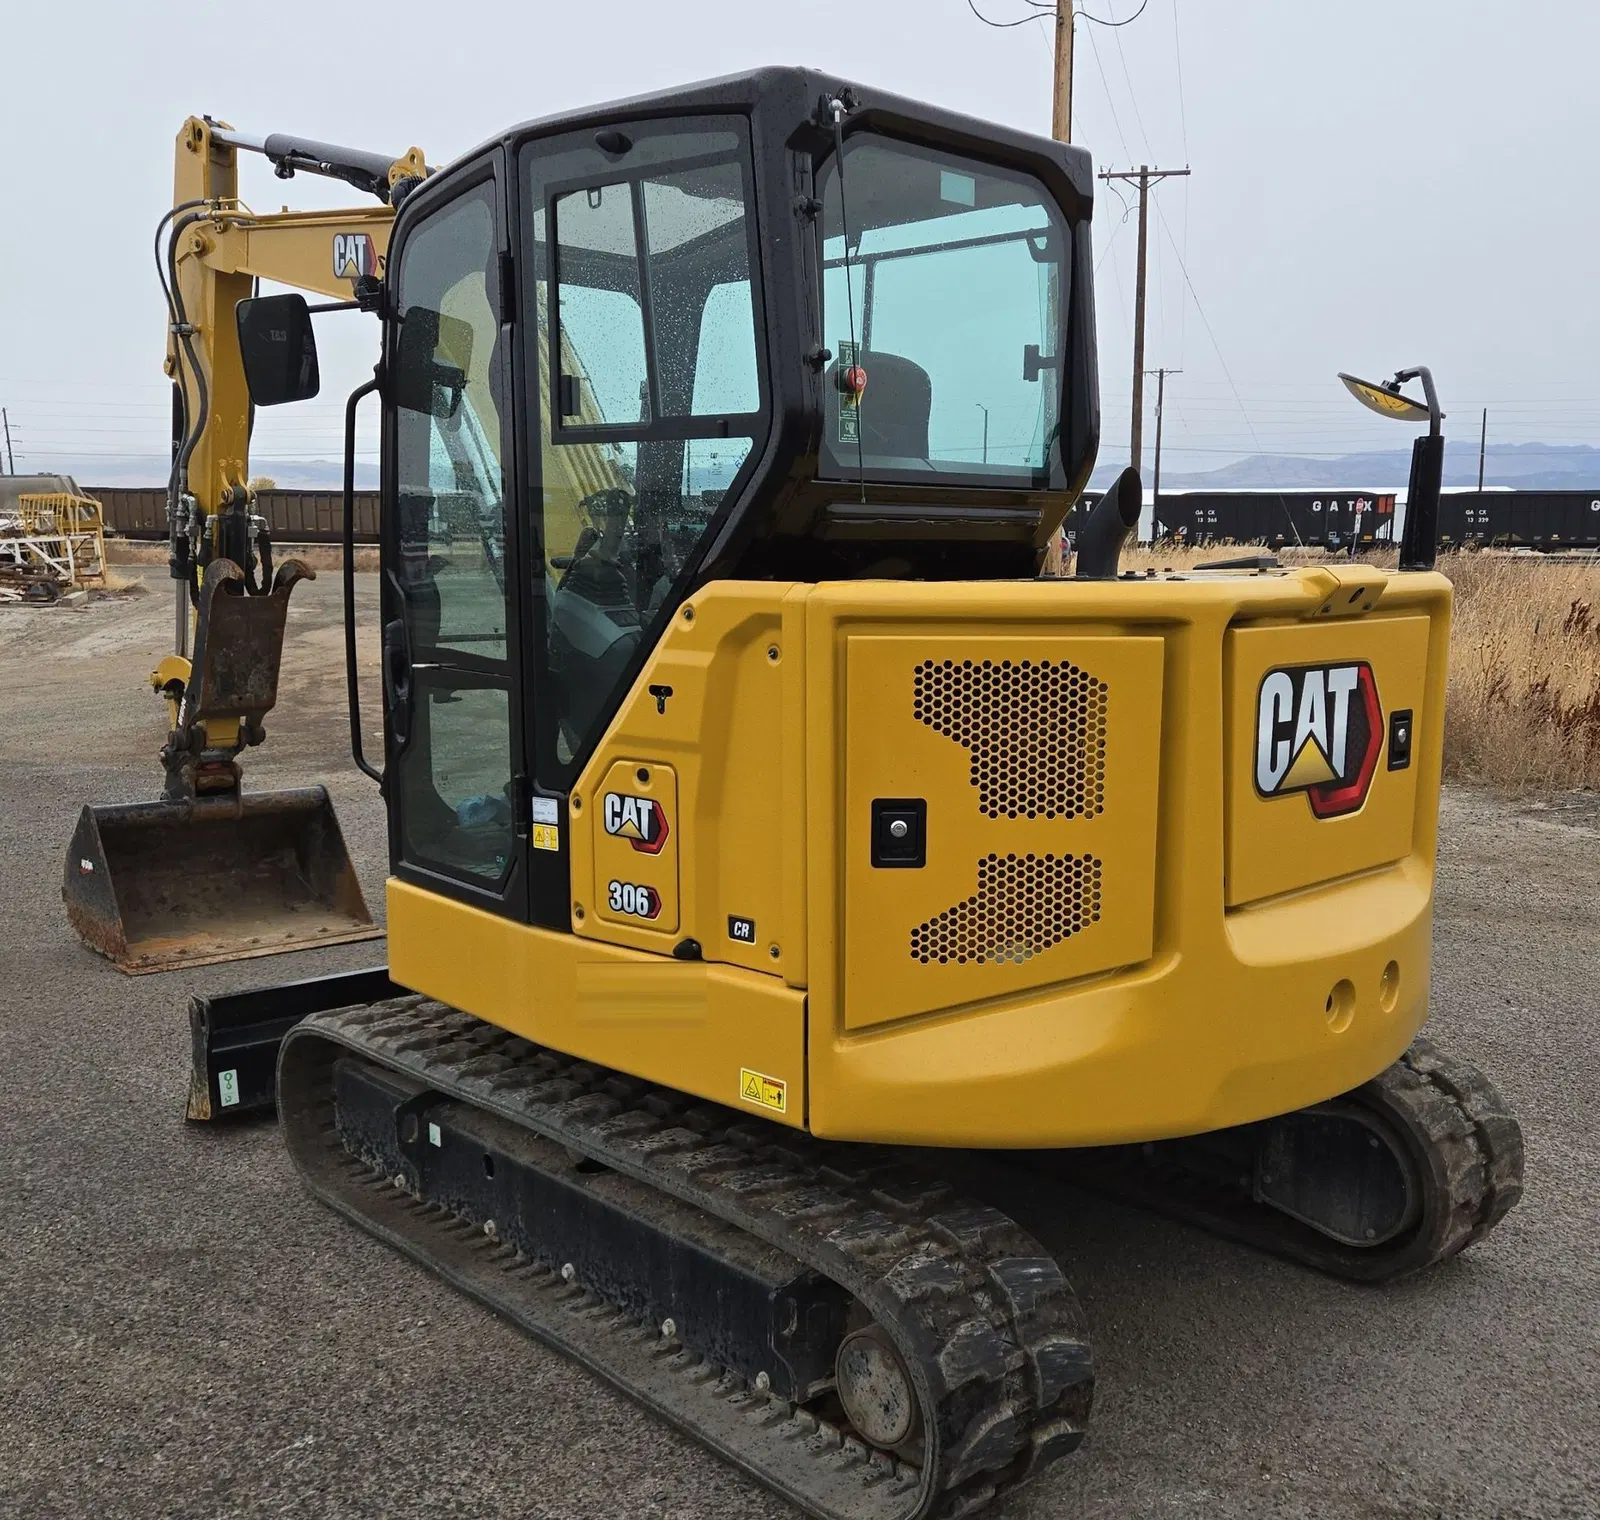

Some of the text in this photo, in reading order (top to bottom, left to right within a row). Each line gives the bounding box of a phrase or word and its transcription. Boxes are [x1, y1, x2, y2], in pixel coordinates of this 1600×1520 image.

[334, 234, 366, 277] CAT
[1312, 500, 1373, 512] GATX
[1257, 666, 1359, 792] CAT
[604, 793, 653, 840] CAT
[608, 881, 649, 916] 306
[733, 921, 750, 938] CR
